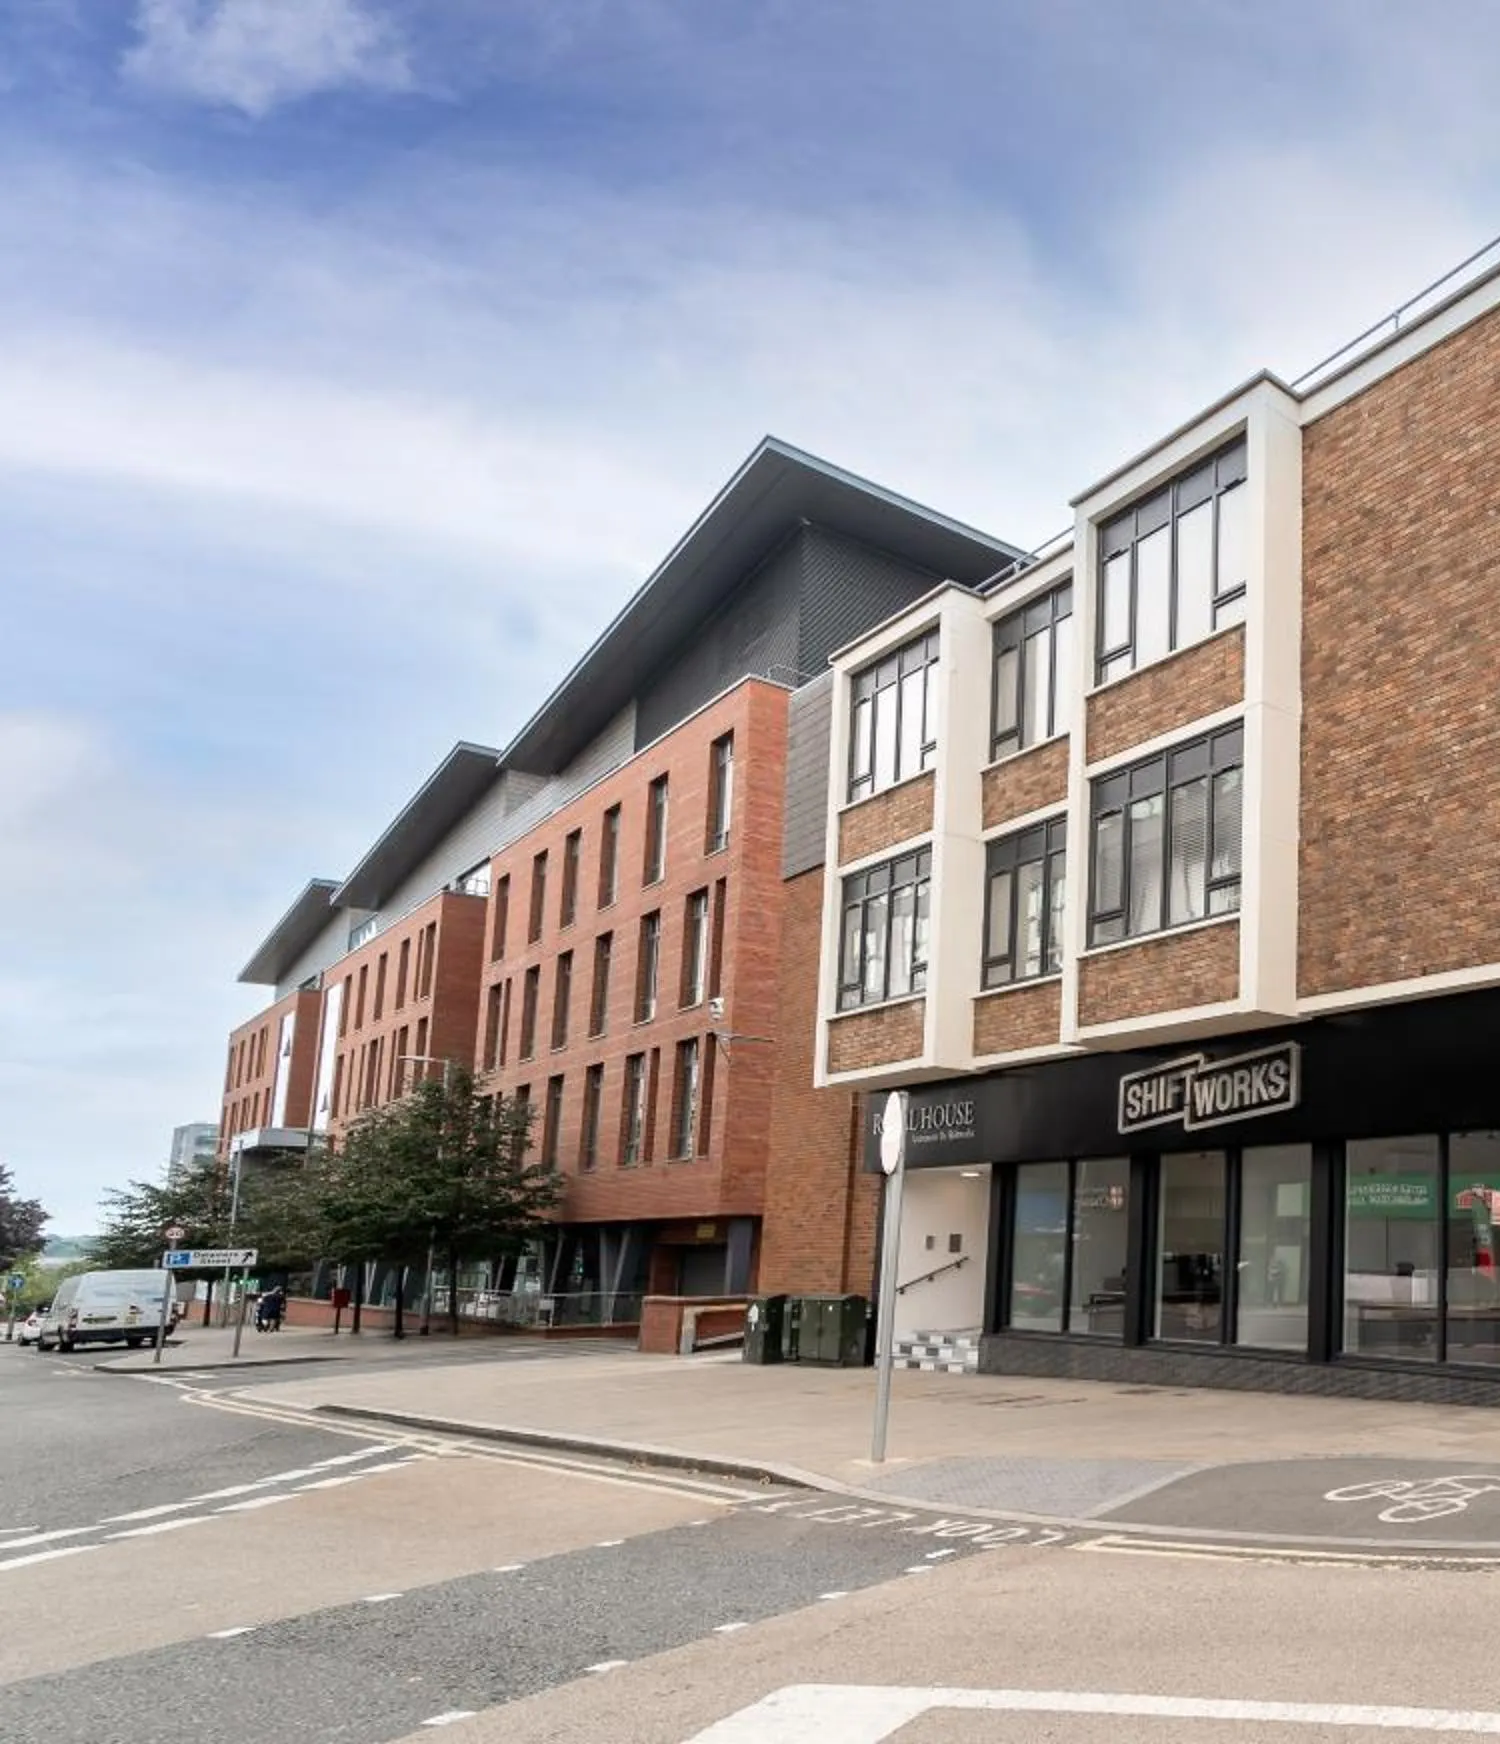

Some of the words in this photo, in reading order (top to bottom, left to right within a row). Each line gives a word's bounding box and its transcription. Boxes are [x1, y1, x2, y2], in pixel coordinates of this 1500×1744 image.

[1126, 1068, 1197, 1119] SHIFT
[1193, 1059, 1288, 1117] WORKS
[920, 1101, 975, 1130] HOUSE
